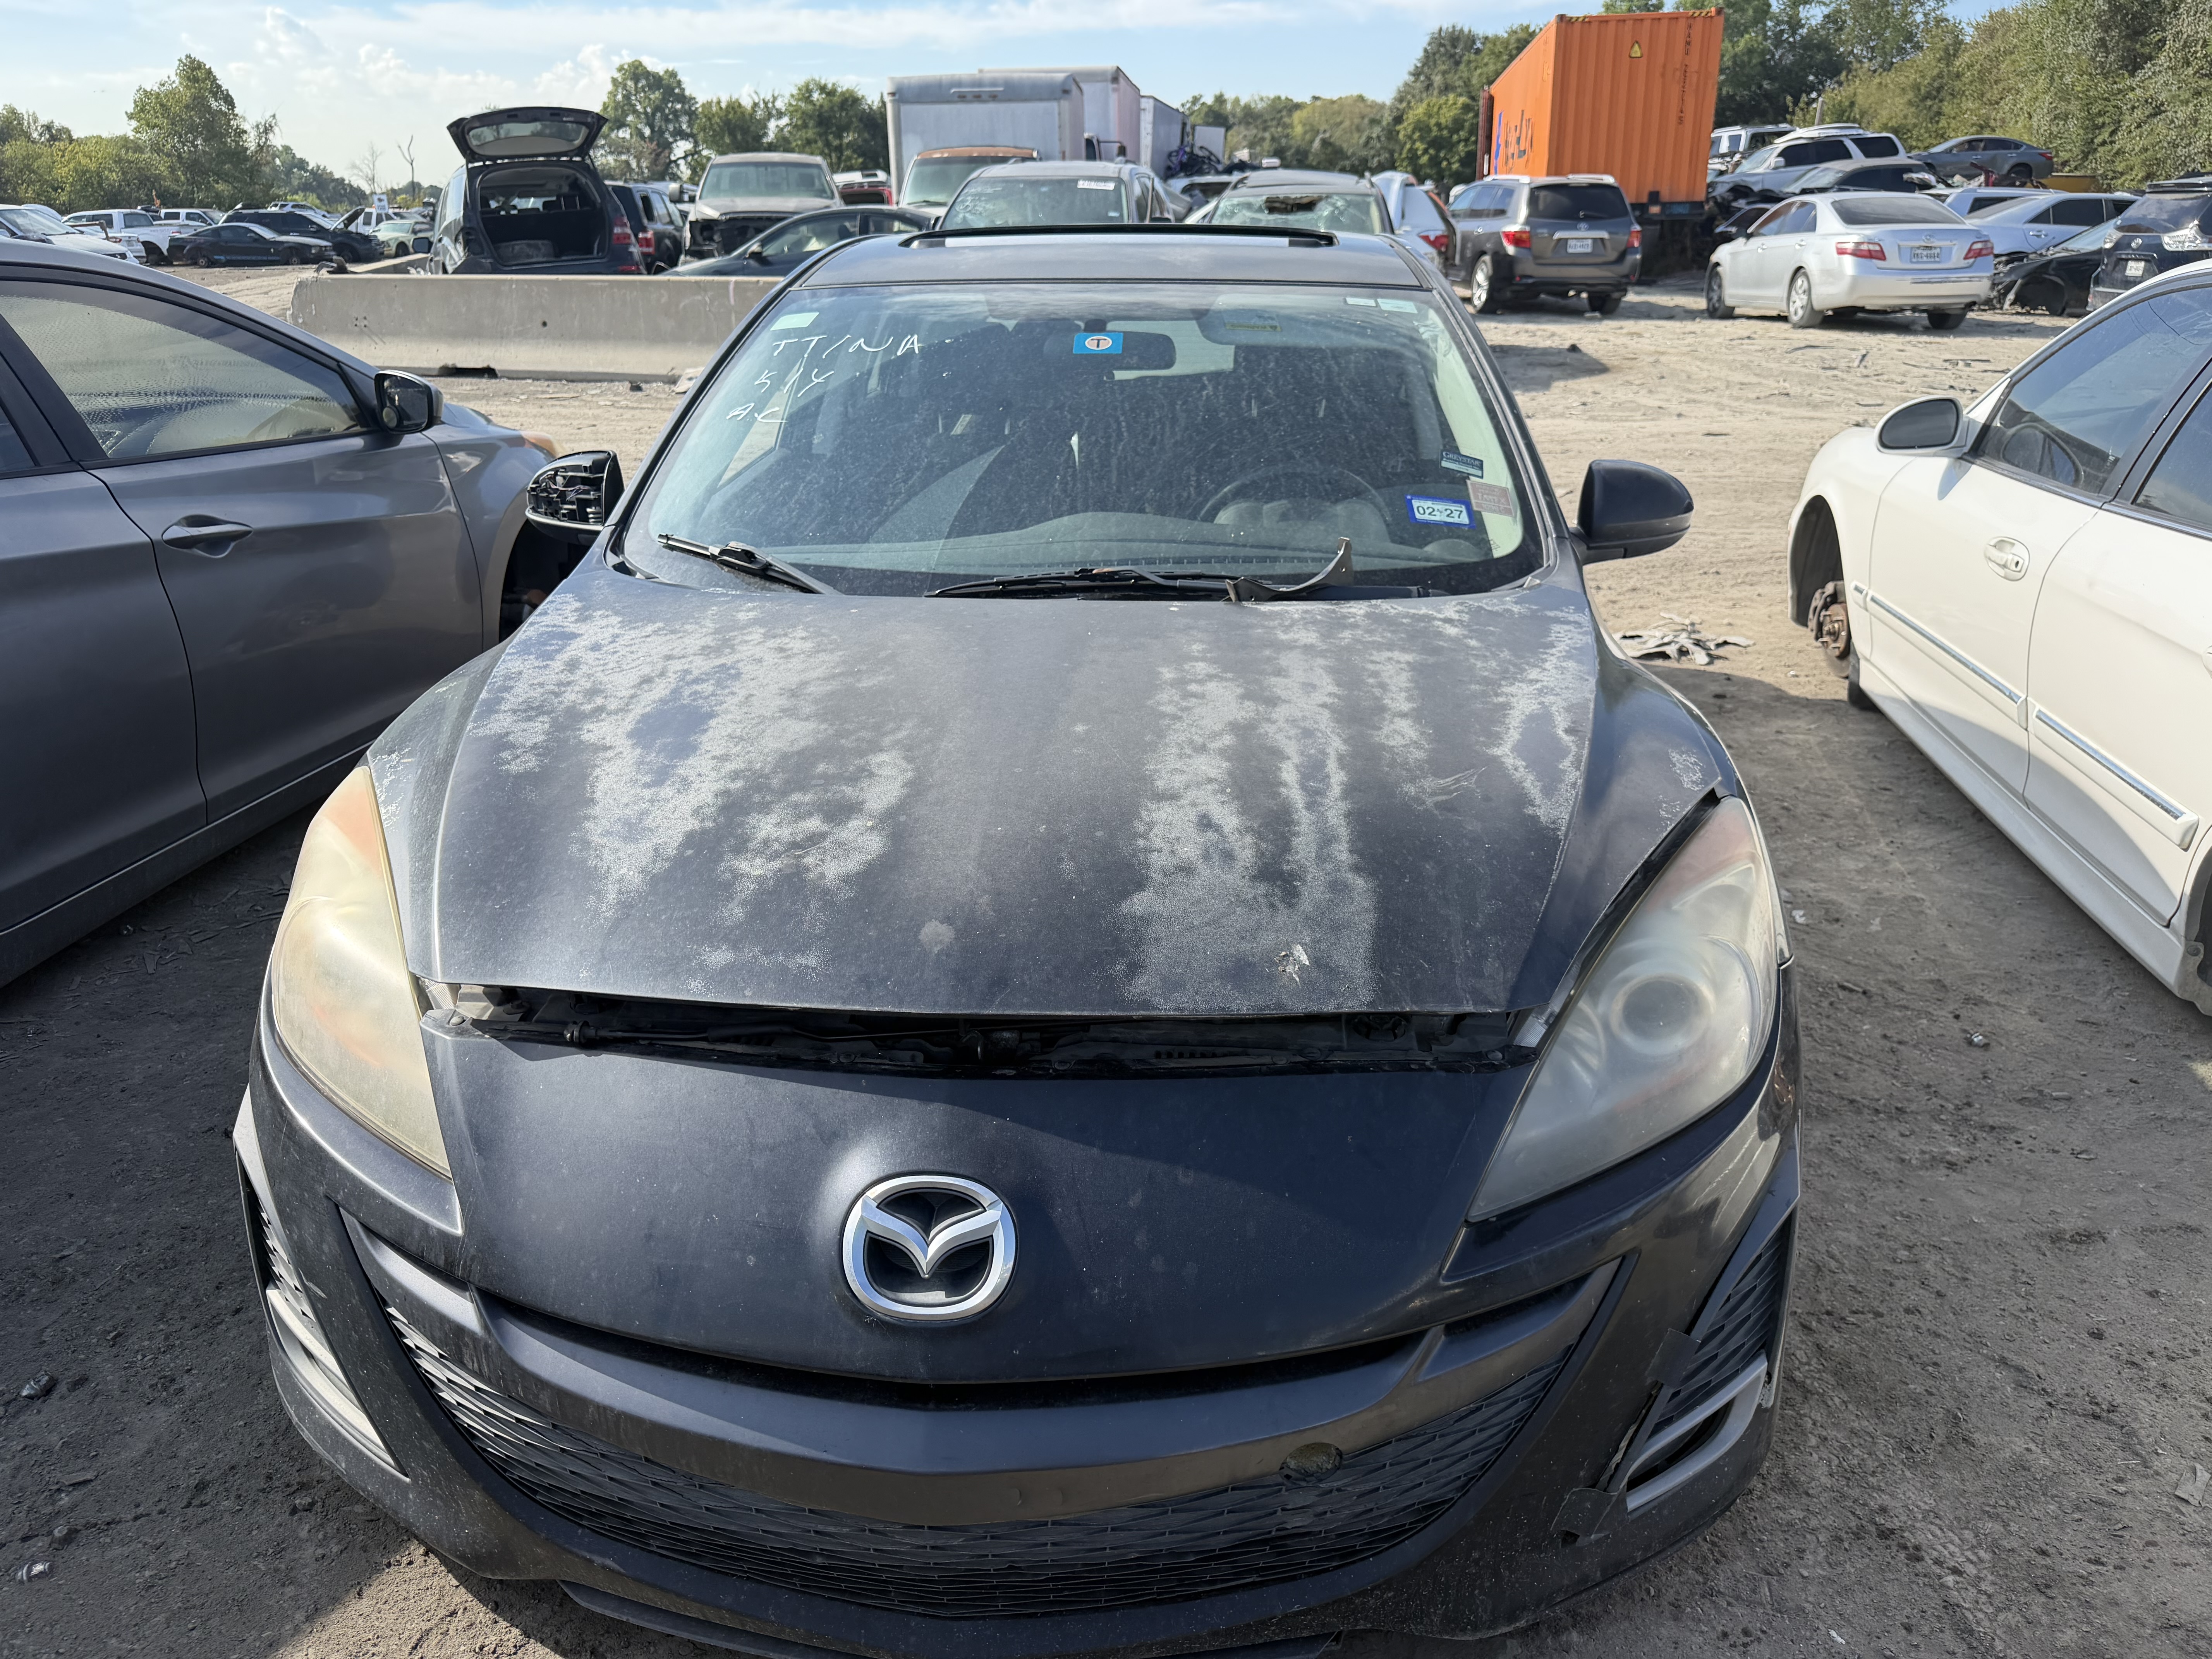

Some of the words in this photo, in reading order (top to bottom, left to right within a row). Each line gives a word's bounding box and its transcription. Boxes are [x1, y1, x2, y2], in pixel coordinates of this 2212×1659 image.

[1091, 338, 1107, 349] T
[1416, 505, 1437, 517] 02
[1444, 508, 1463, 519] 27
